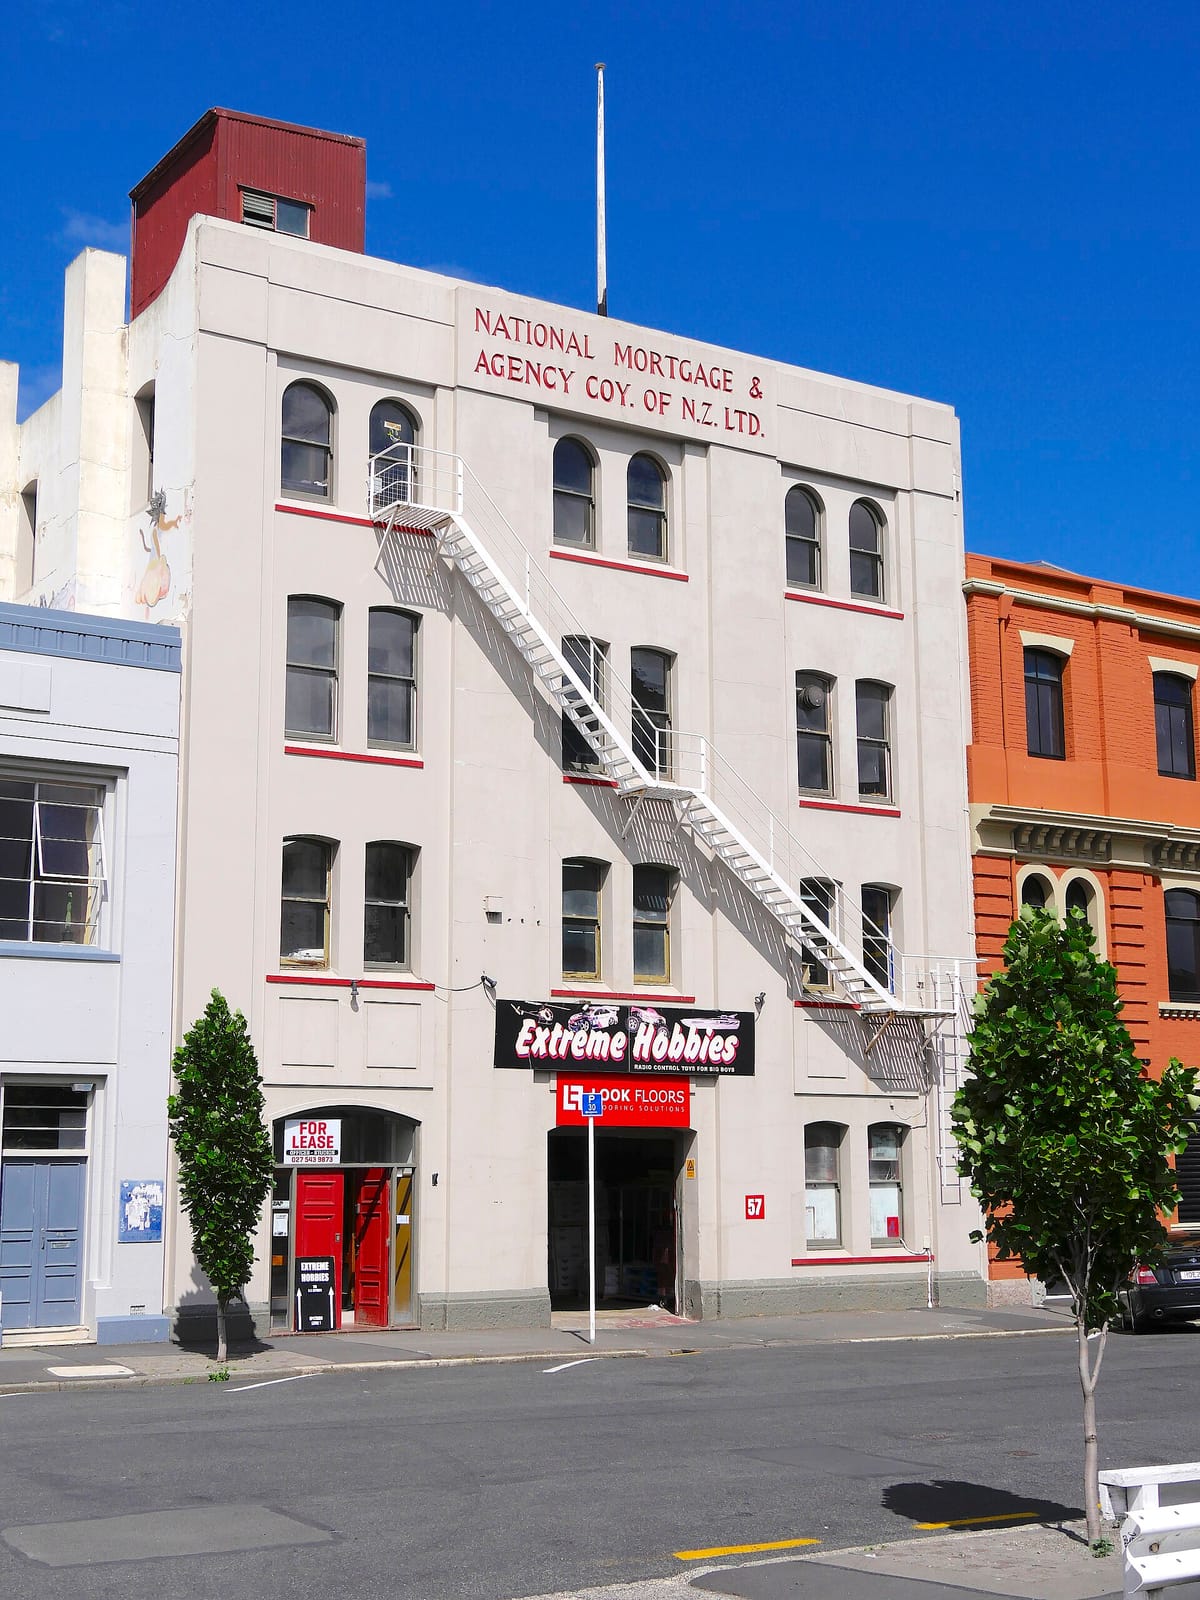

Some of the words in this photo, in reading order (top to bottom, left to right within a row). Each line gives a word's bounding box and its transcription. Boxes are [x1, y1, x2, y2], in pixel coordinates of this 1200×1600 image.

[474, 307, 596, 360] NATIONAL
[613, 342, 734, 393] MORTGAGE
[749, 376, 763, 399] &
[473, 349, 576, 394] AGENCY
[585, 375, 635, 408] COY.
[643, 389, 673, 416] OF
[724, 407, 766, 438] LTD.
[515, 1018, 629, 1062] Extreme
[632, 1022, 740, 1066] Hobbies
[588, 1095, 596, 1104] P
[635, 1089, 685, 1104] FLOORS
[602, 1104, 634, 1112] OORING
[639, 1105, 685, 1113] SOLUTIONS
[299, 1121, 327, 1135] FOR
[292, 1135, 334, 1149] LEASE
[747, 1198, 763, 1216] 57
[300, 1262, 330, 1271] EXTREME
[300, 1272, 330, 1283] HOBBIES
